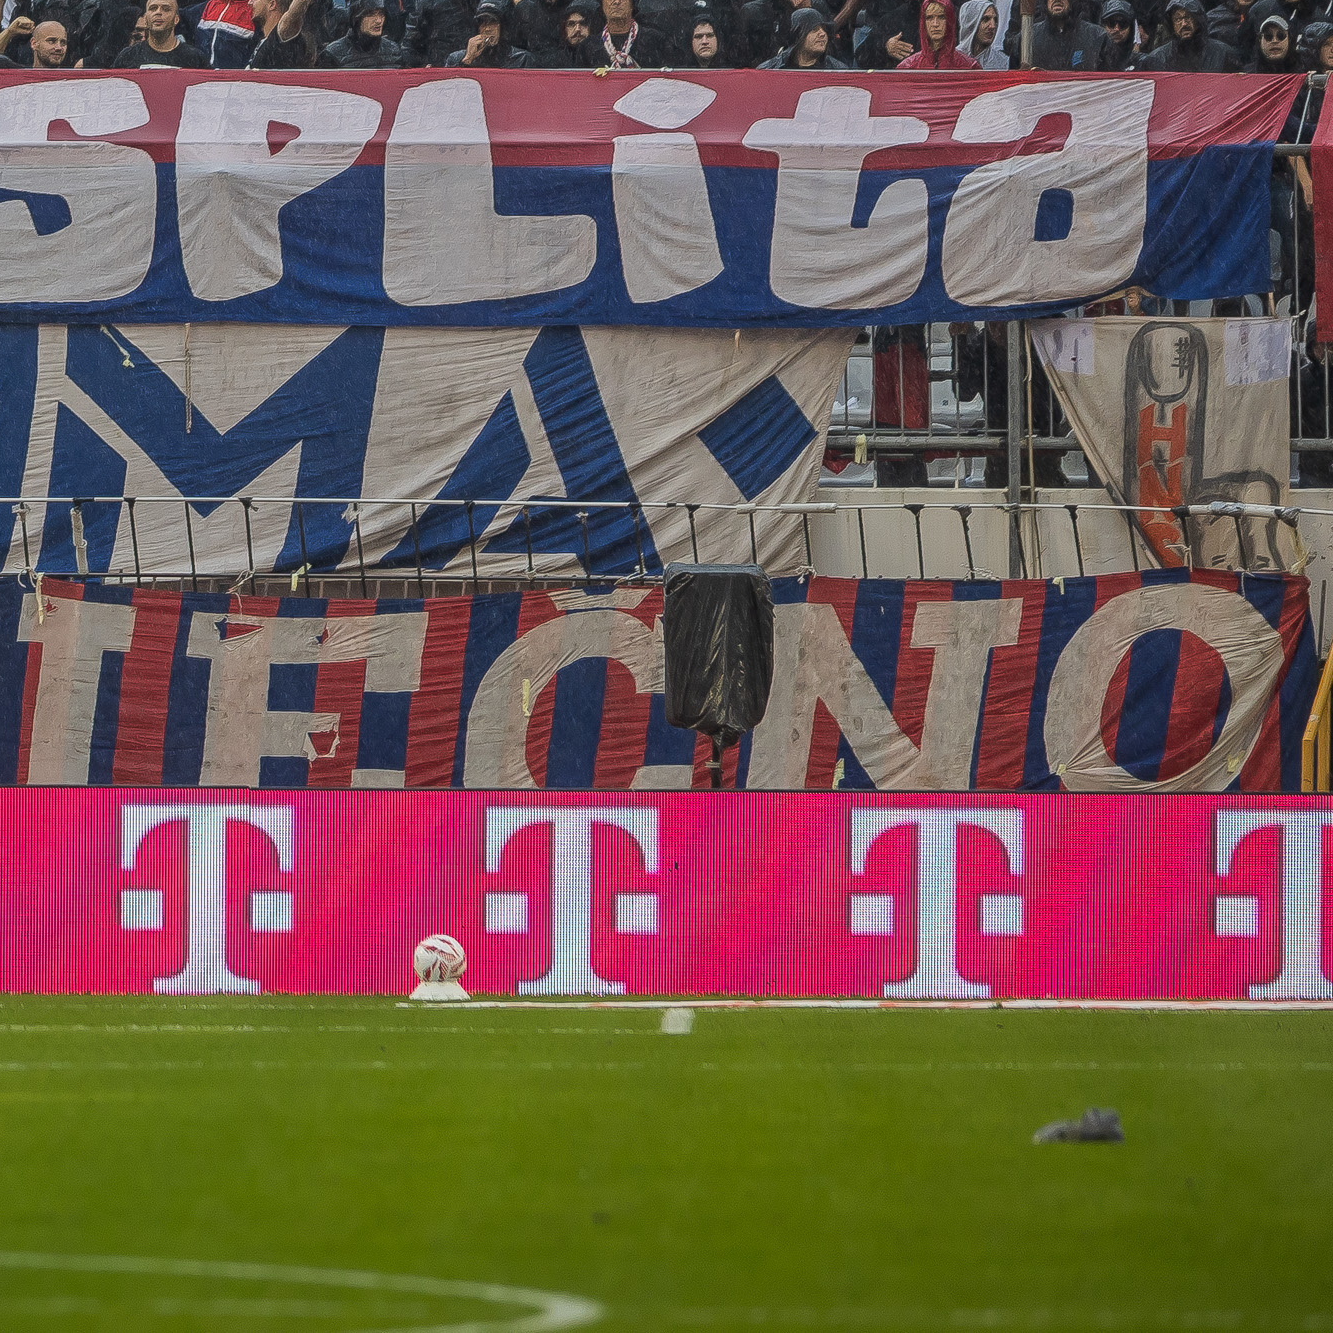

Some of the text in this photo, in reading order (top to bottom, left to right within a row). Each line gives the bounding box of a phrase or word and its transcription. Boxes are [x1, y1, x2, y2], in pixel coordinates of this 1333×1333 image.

[121, 804, 293, 994] T
[485, 806, 658, 996] T
[851, 807, 1024, 998] T
